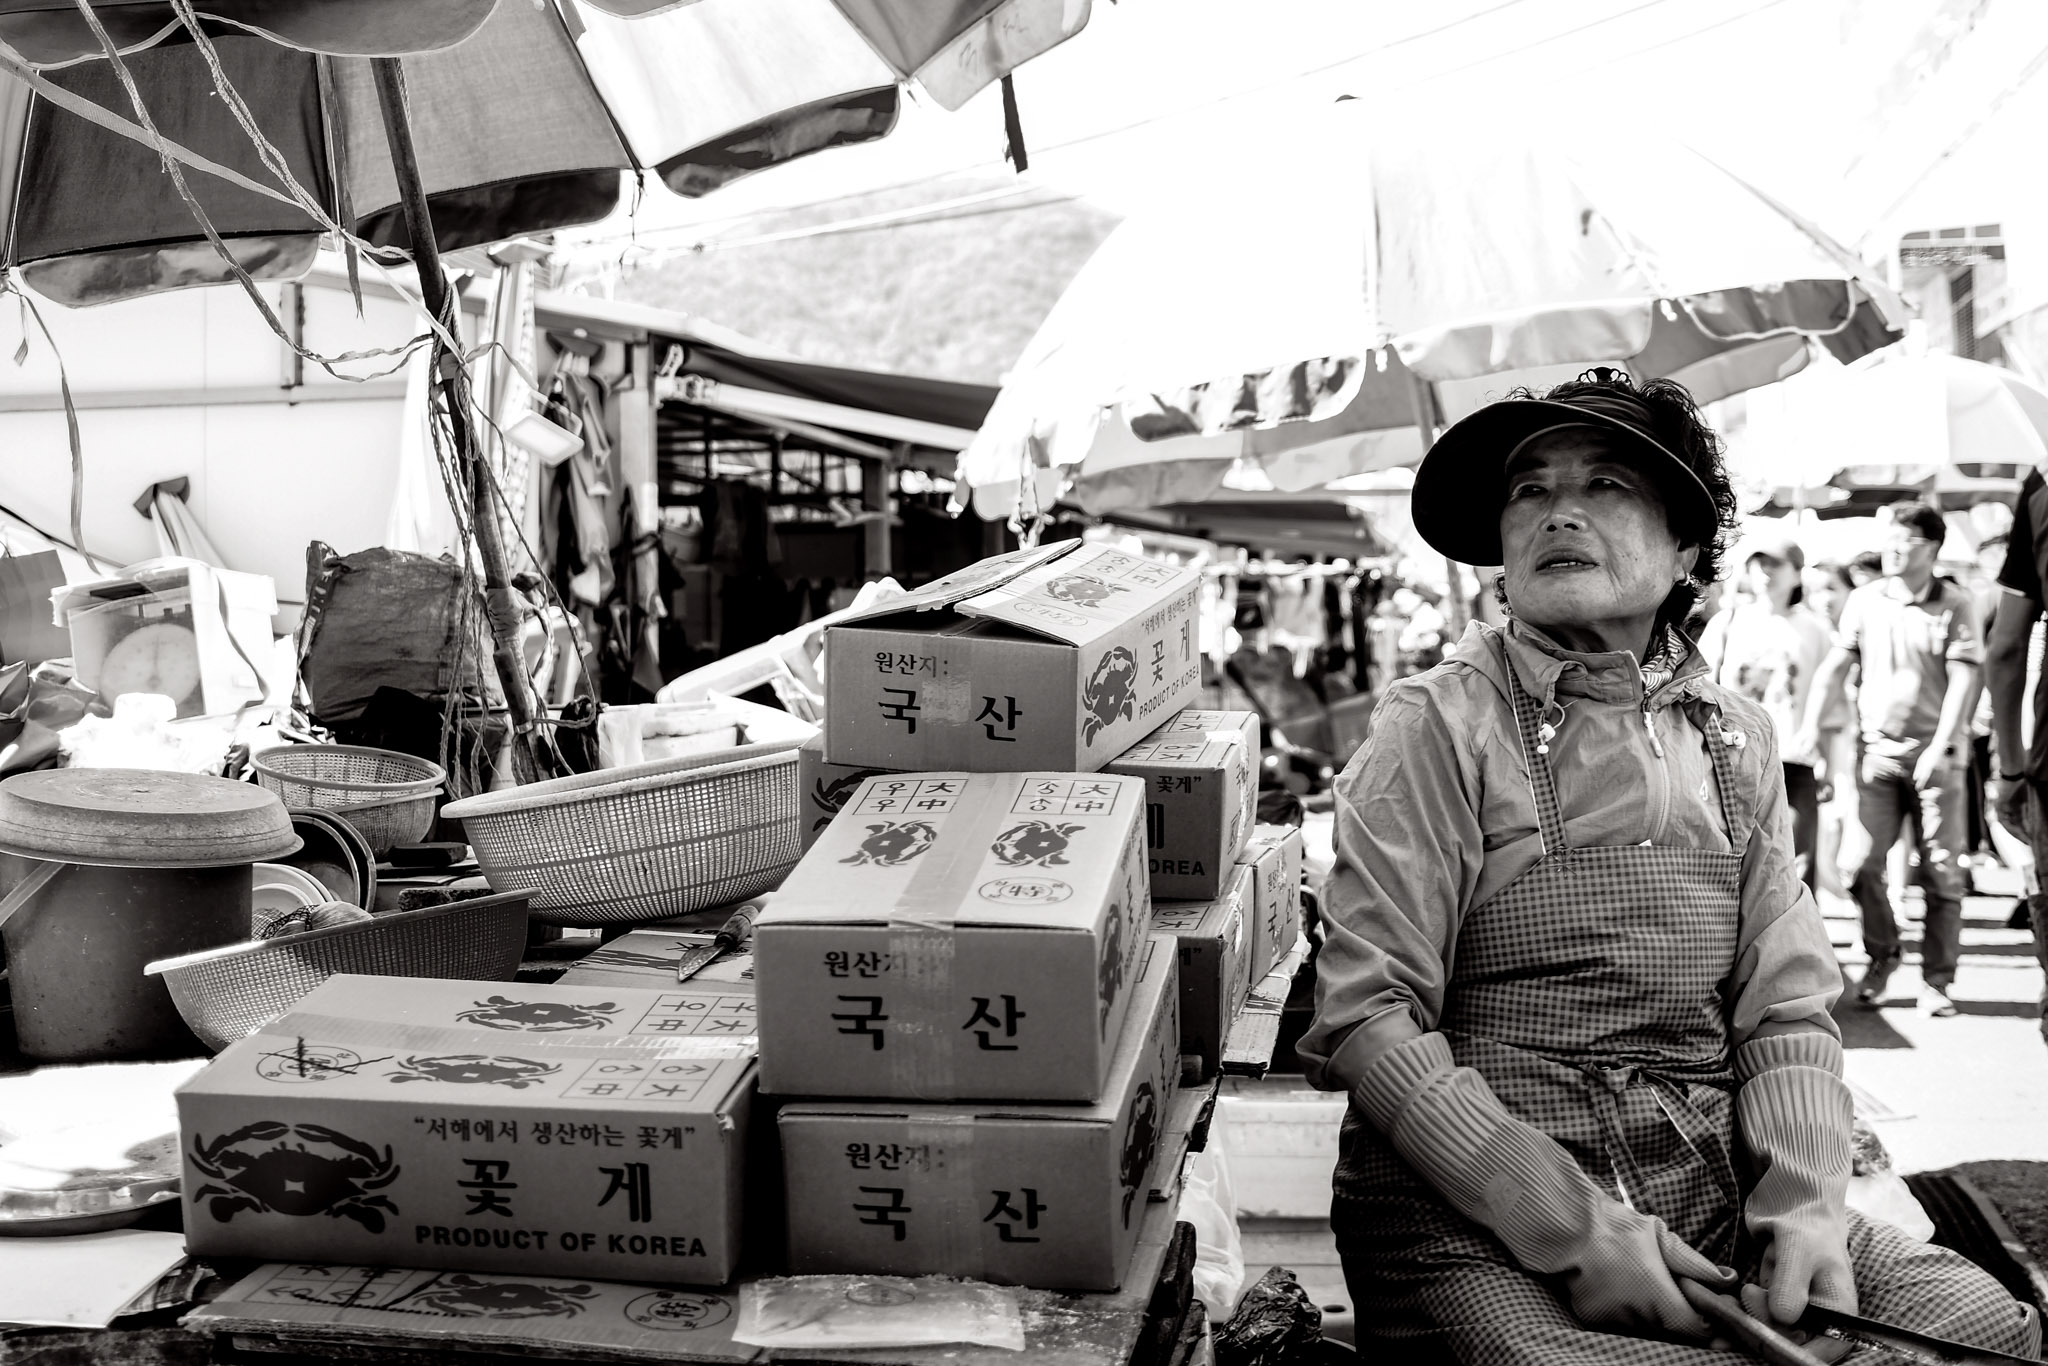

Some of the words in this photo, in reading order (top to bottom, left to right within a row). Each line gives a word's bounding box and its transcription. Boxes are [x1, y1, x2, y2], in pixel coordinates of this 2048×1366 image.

[874, 652, 949, 678] 원산지:
[1139, 686, 1170, 720] PRODUCT
[1172, 679, 1180, 696] OF
[1181, 664, 1199, 689] KOREA
[925, 782, 957, 794] 大
[1080, 784, 1112, 796] 大
[917, 798, 947, 811] 中
[1074, 800, 1104, 813] 中
[1150, 859, 1206, 876] OREA
[414, 1116, 518, 1143] “서해에서
[530, 1121, 626, 1148] 생산하는
[636, 1125, 697, 1150] 꽃게”
[415, 1224, 549, 1251] PRODUCT
[560, 1231, 596, 1252] OF
[608, 1233, 708, 1257] KOREA
